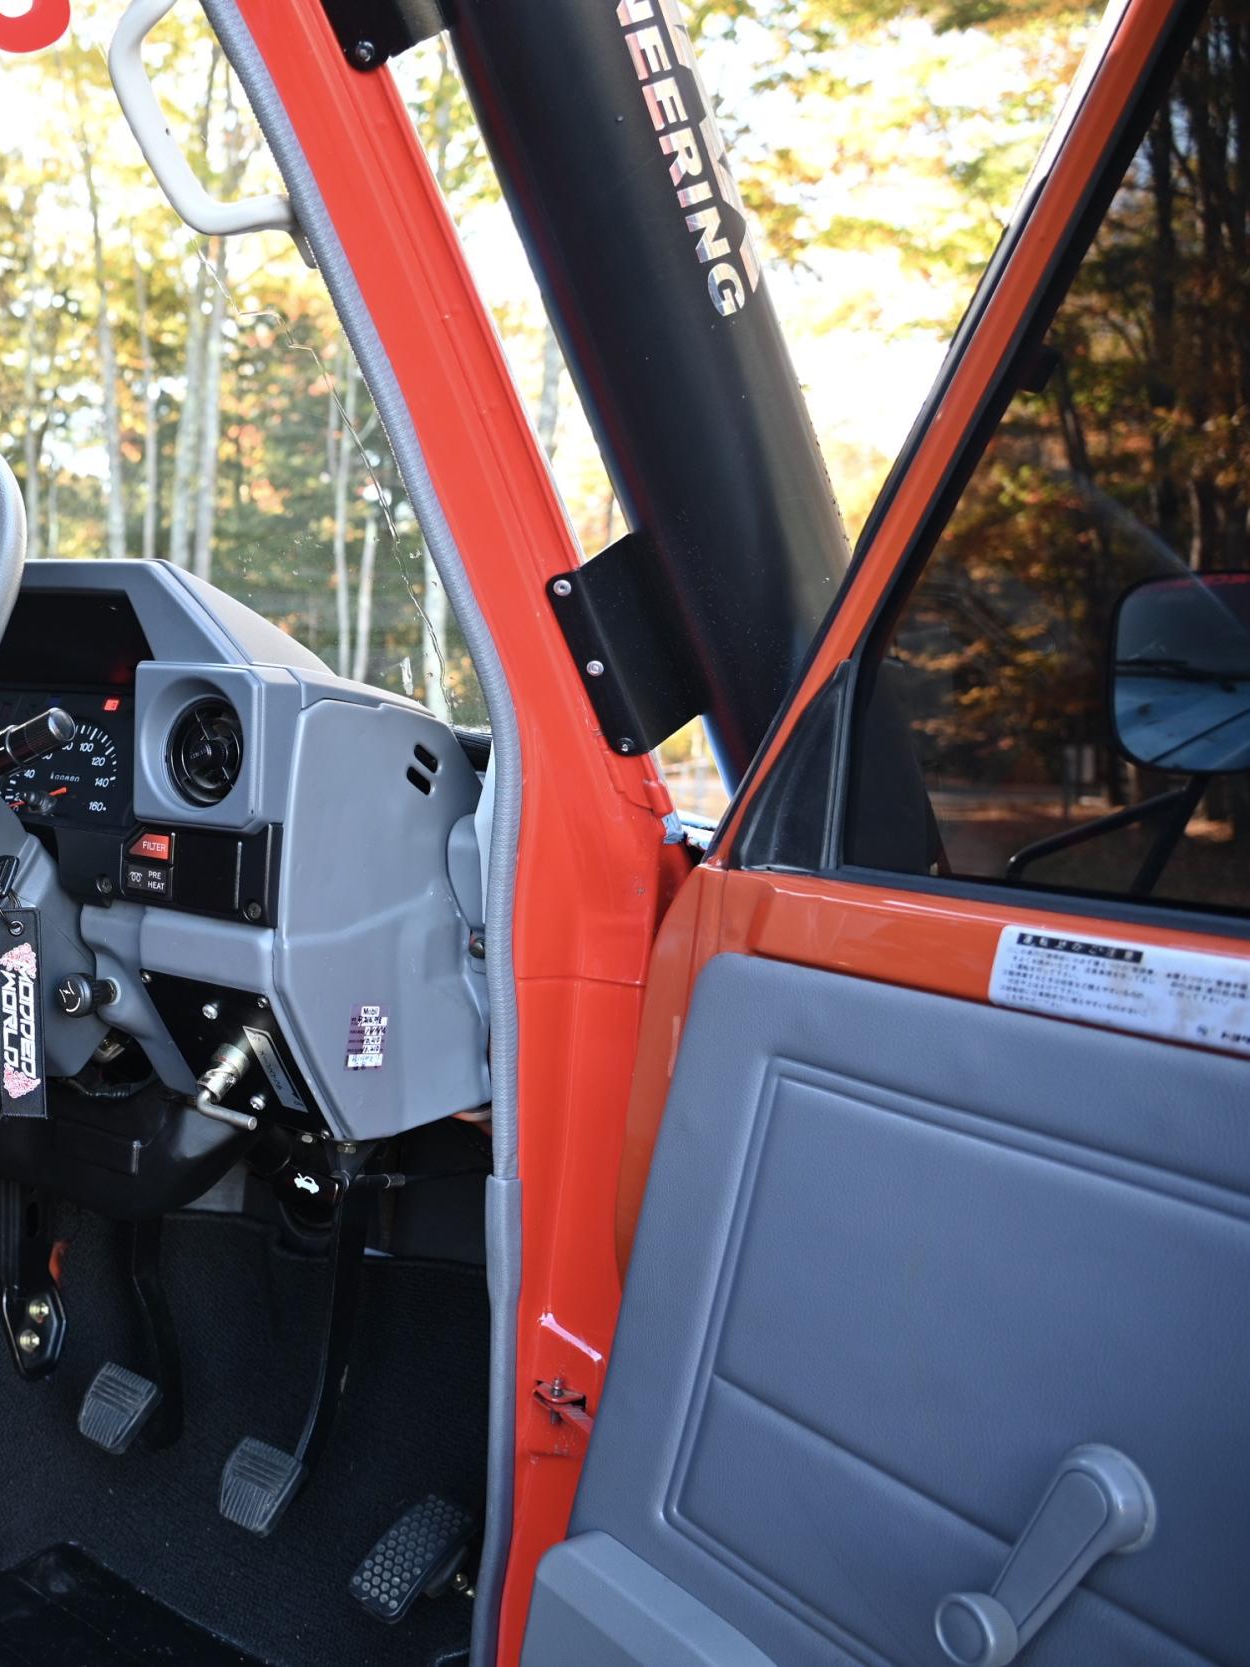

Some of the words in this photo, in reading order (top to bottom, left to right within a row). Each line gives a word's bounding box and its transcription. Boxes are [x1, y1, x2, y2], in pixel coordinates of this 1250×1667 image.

[80, 743, 94, 752] 100
[91, 757, 105, 767] 120
[24, 769, 36, 779] 40
[94, 778, 109, 788] 140
[89, 802, 103, 812] 160
[142, 840, 167, 852] FILTER
[148, 870, 162, 880] PRE
[147, 880, 165, 890] HEAT
[0, 969, 19, 1069] WORLD
